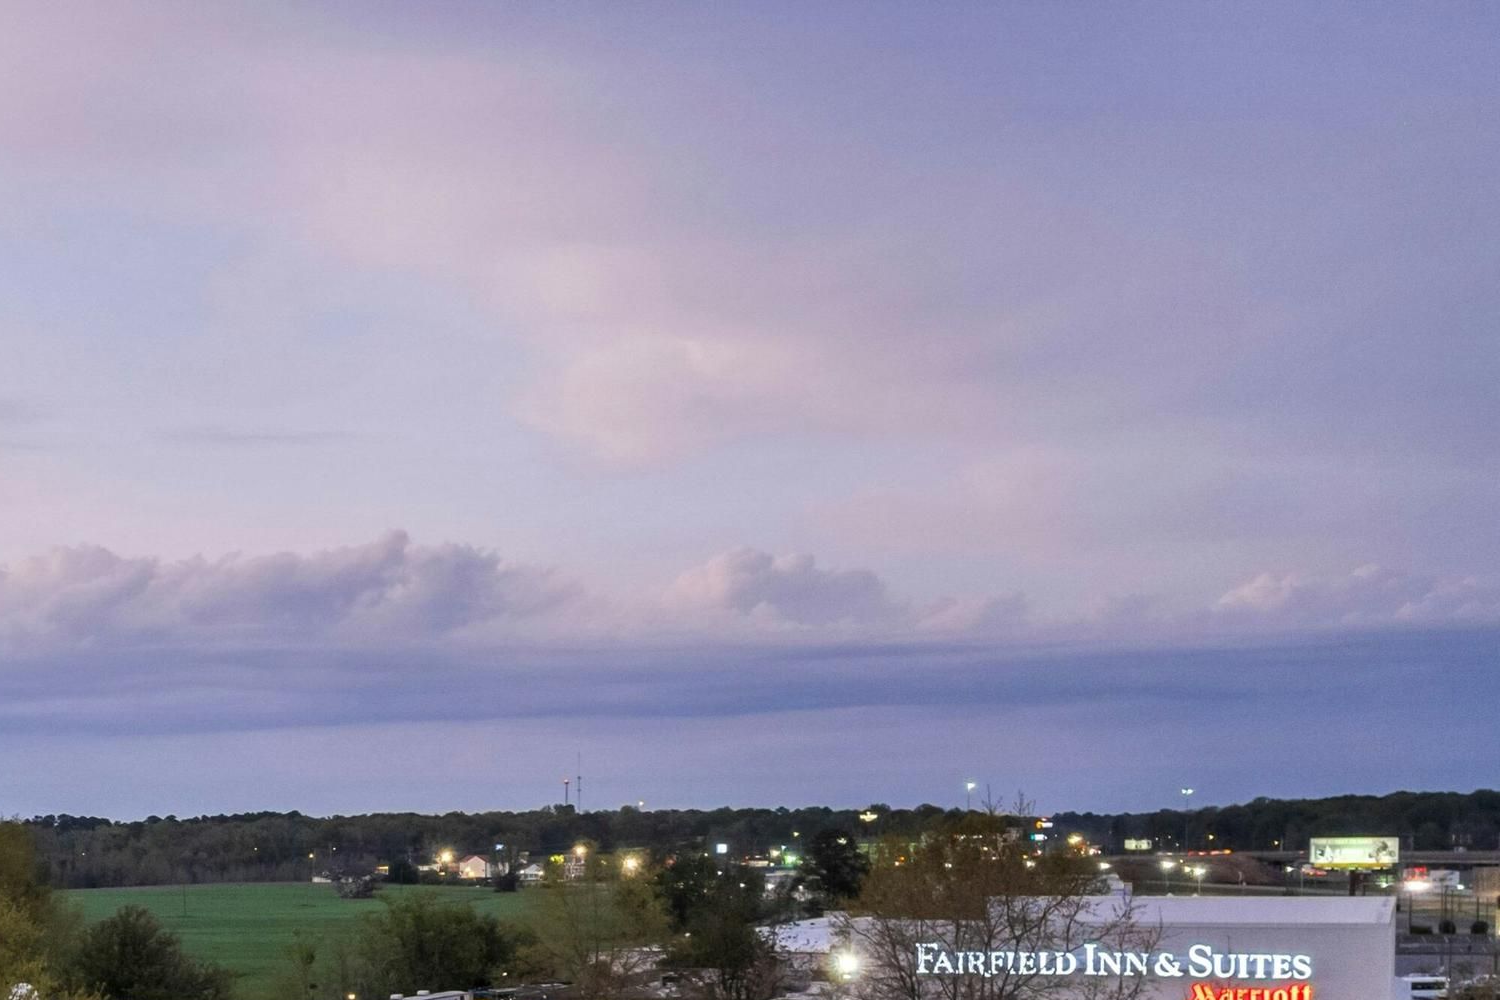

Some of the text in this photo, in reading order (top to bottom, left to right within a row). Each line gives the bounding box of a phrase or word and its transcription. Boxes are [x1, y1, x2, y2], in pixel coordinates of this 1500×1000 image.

[915, 943, 1312, 979] FAIRFIELD INN & SUITES
